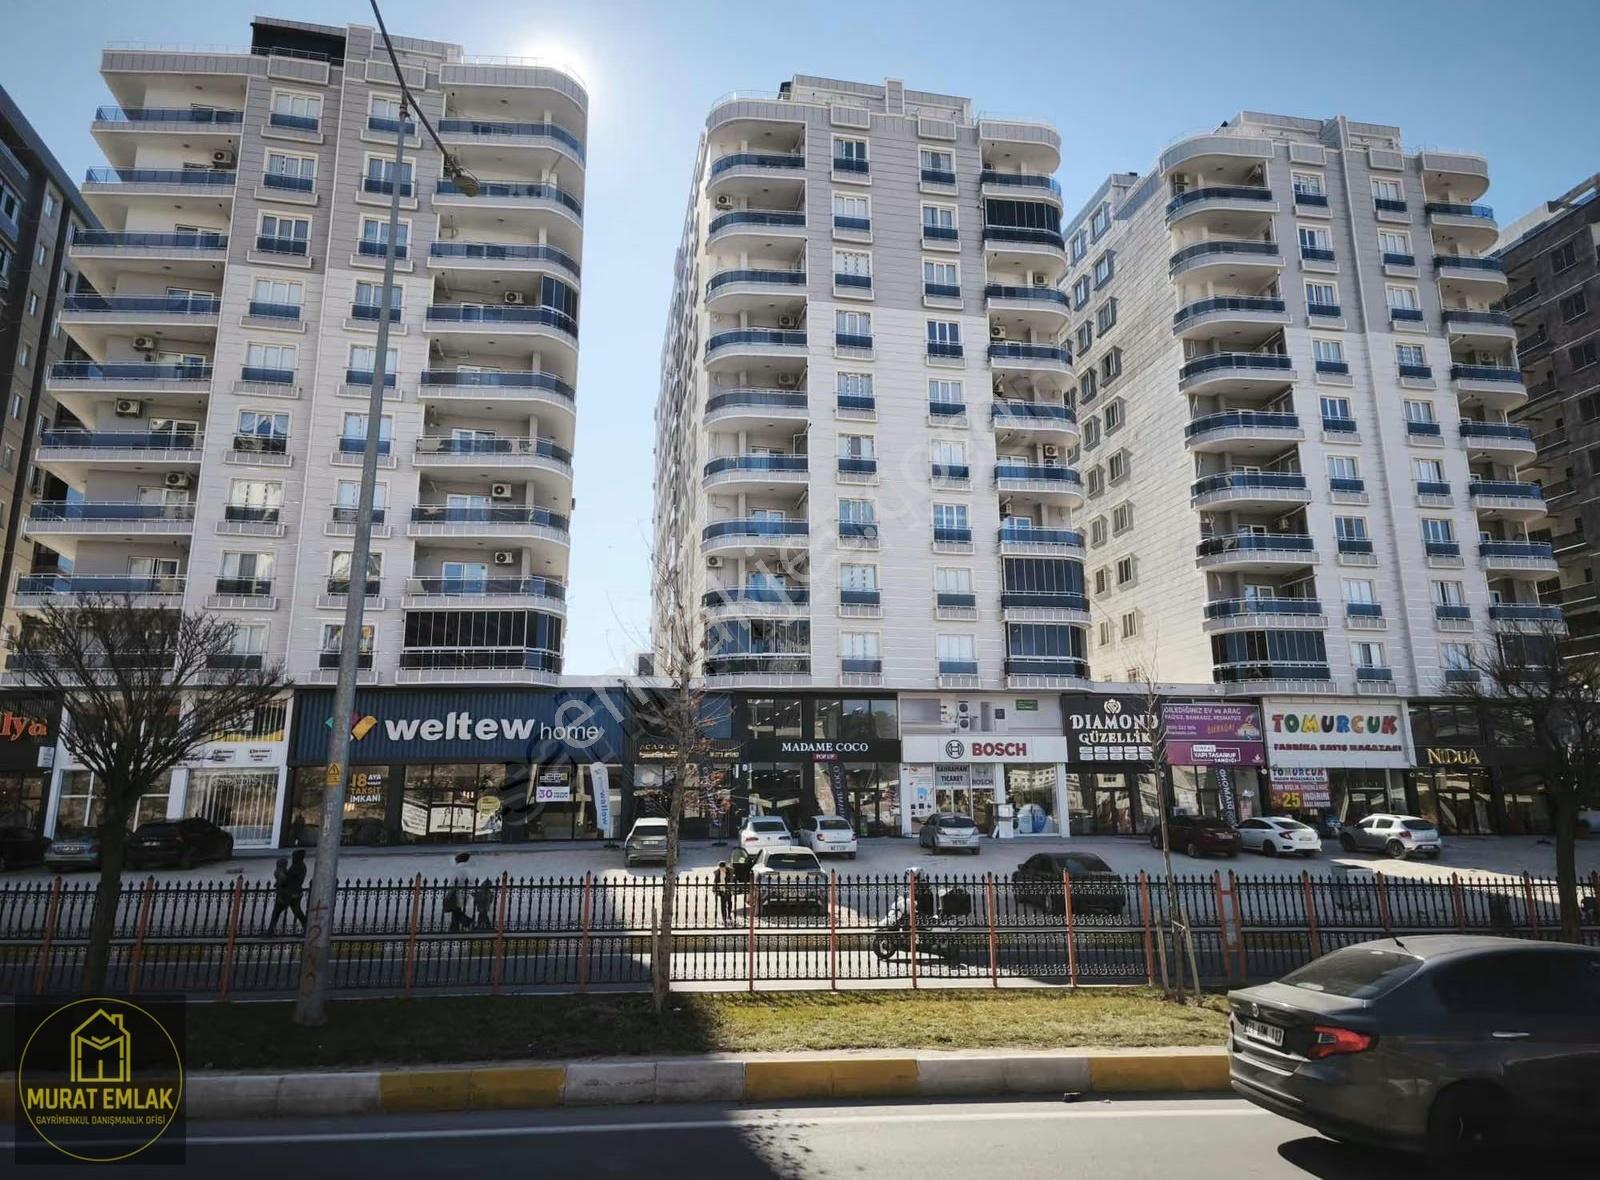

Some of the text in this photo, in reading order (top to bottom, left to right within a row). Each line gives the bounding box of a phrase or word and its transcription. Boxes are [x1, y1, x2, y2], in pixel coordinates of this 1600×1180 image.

[0, 711, 47, 741] lya
[385, 712, 600, 740] weltew home
[1069, 714, 1159, 729] DIAMOND
[1272, 714, 1397, 734] TOMURCUK
[1079, 730, 1151, 745] GÜZELLİK
[781, 742, 869, 752] MADAME COCO
[972, 742, 1027, 756] BOSCH
[1272, 767, 1325, 776] TOMURCUK
[352, 772, 367, 787] 18
[539, 789, 553, 799] 30
